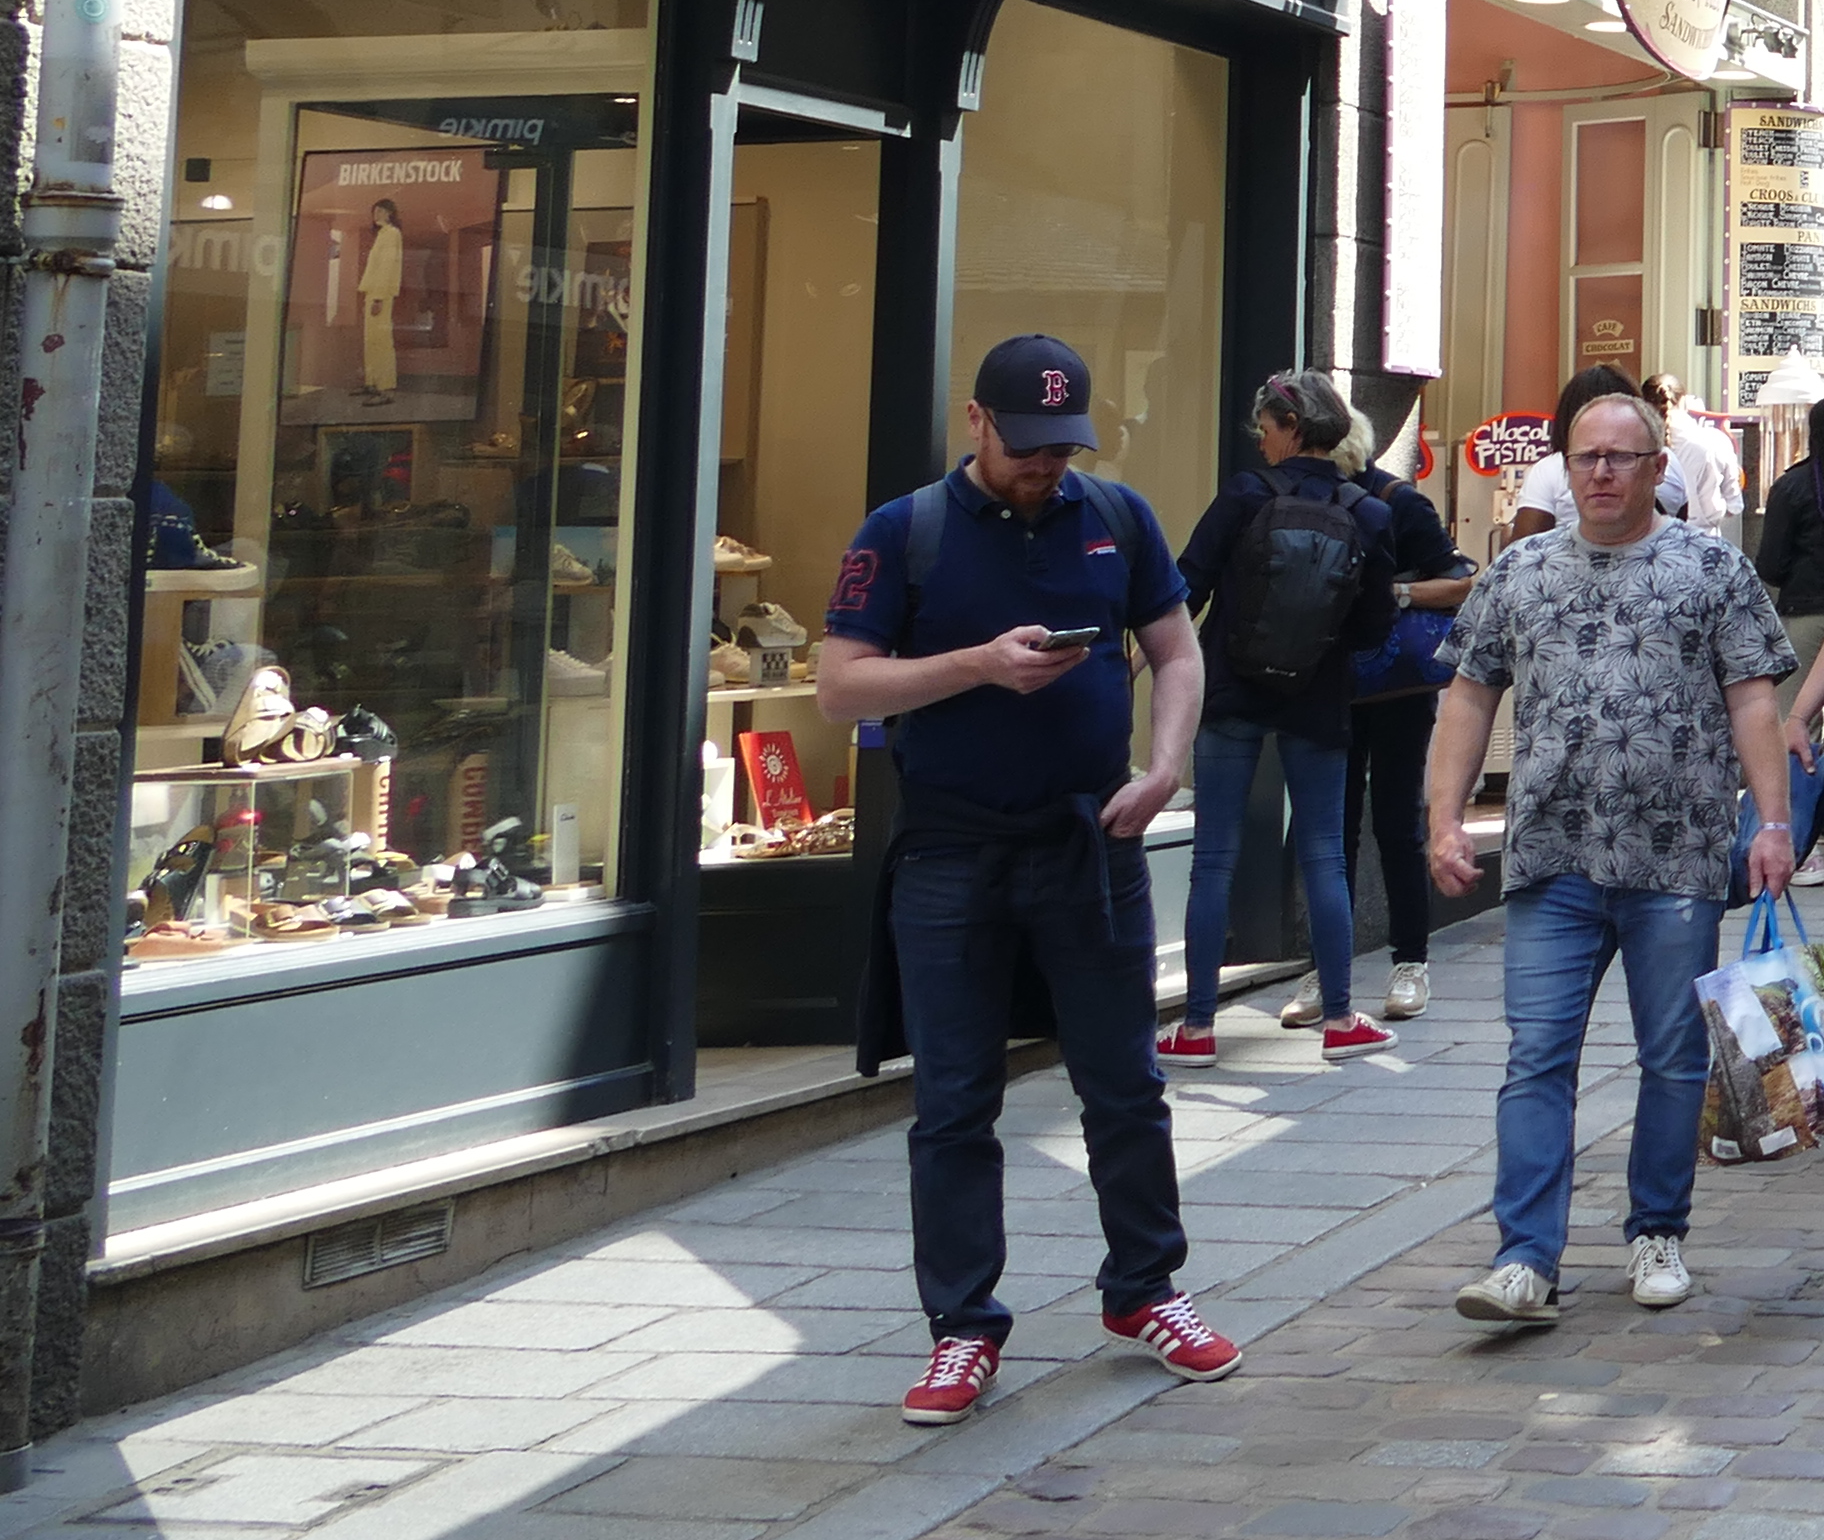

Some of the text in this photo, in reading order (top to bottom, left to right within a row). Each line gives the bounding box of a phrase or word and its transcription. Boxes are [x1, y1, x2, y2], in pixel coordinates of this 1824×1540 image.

[338, 158, 462, 187] BIRKENSTOCK
[1584, 342, 1632, 353] CHOCOLAT
[1041, 369, 1070, 407] B
